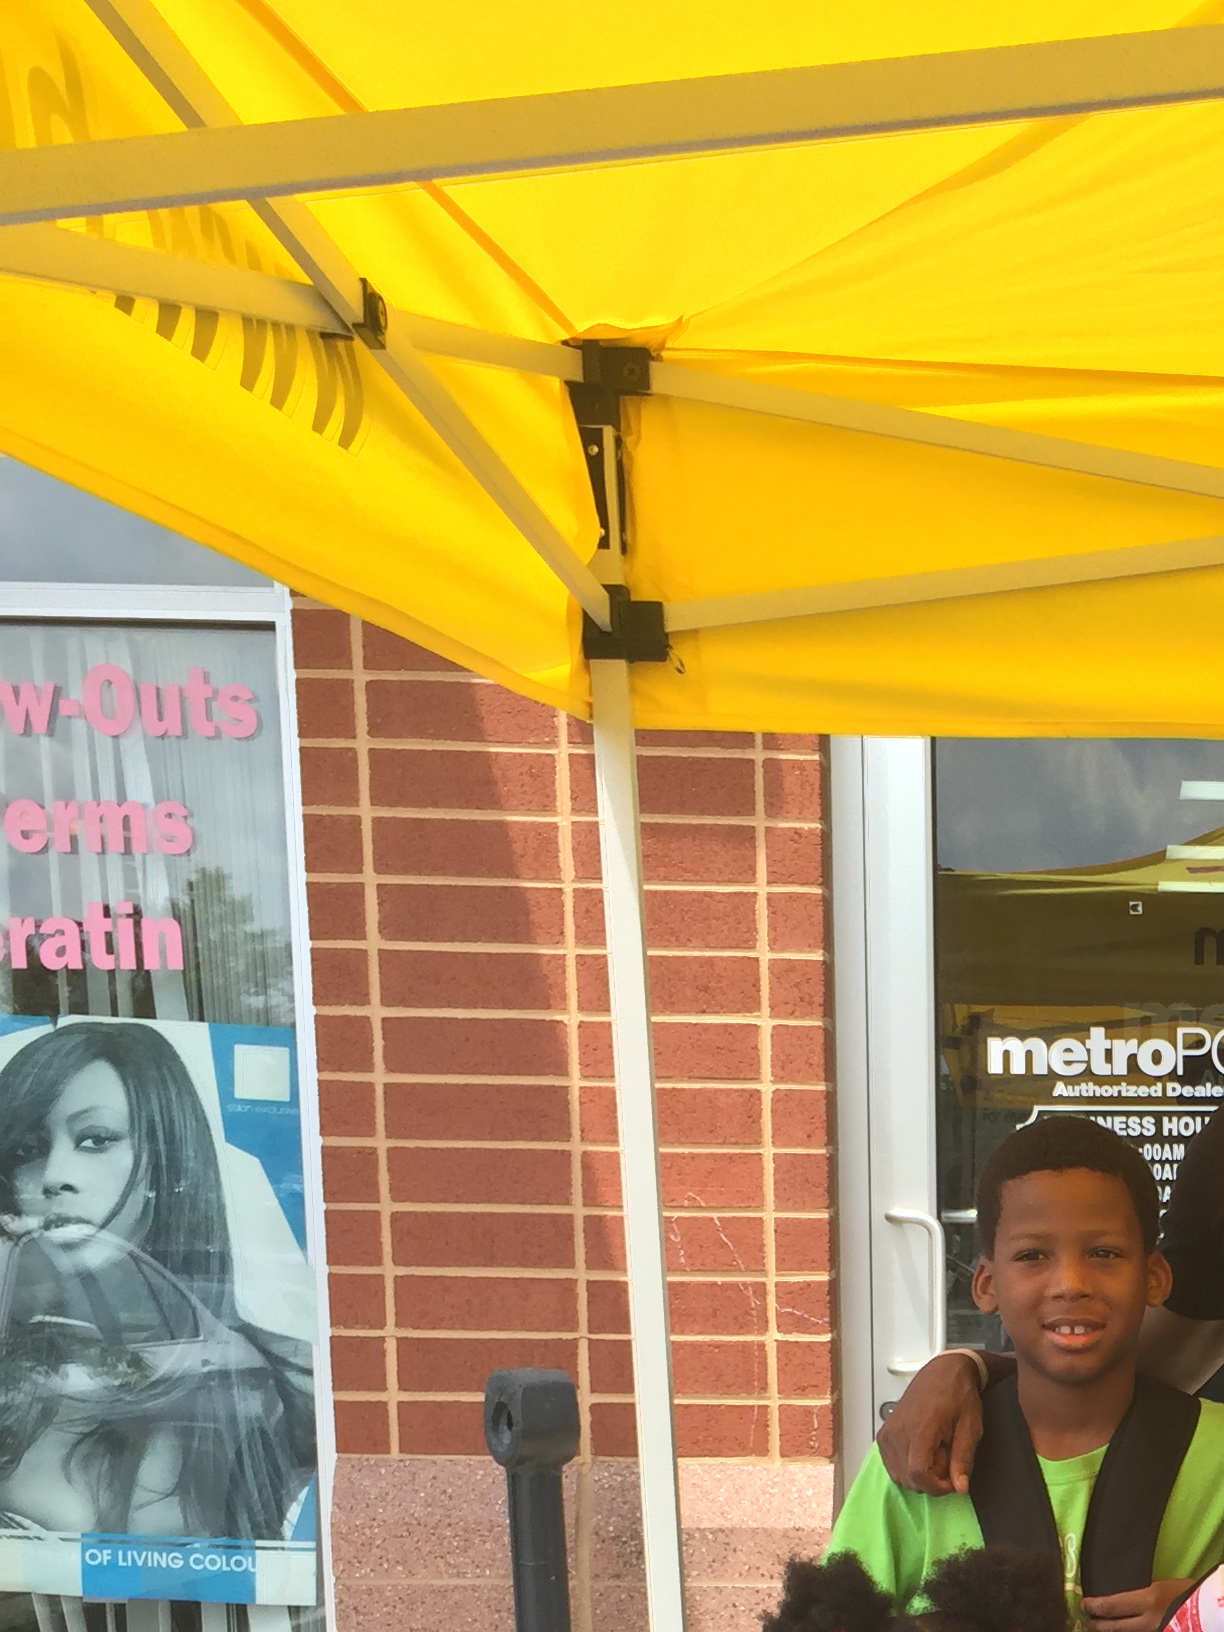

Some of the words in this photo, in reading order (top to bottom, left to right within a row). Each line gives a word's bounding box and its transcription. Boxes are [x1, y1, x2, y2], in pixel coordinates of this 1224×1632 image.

[4, 799, 193, 854] erms
[1053, 1081, 1162, 1098] Authorized
[85, 1549, 112, 1567] OF
[118, 1550, 184, 1569] LIVING
